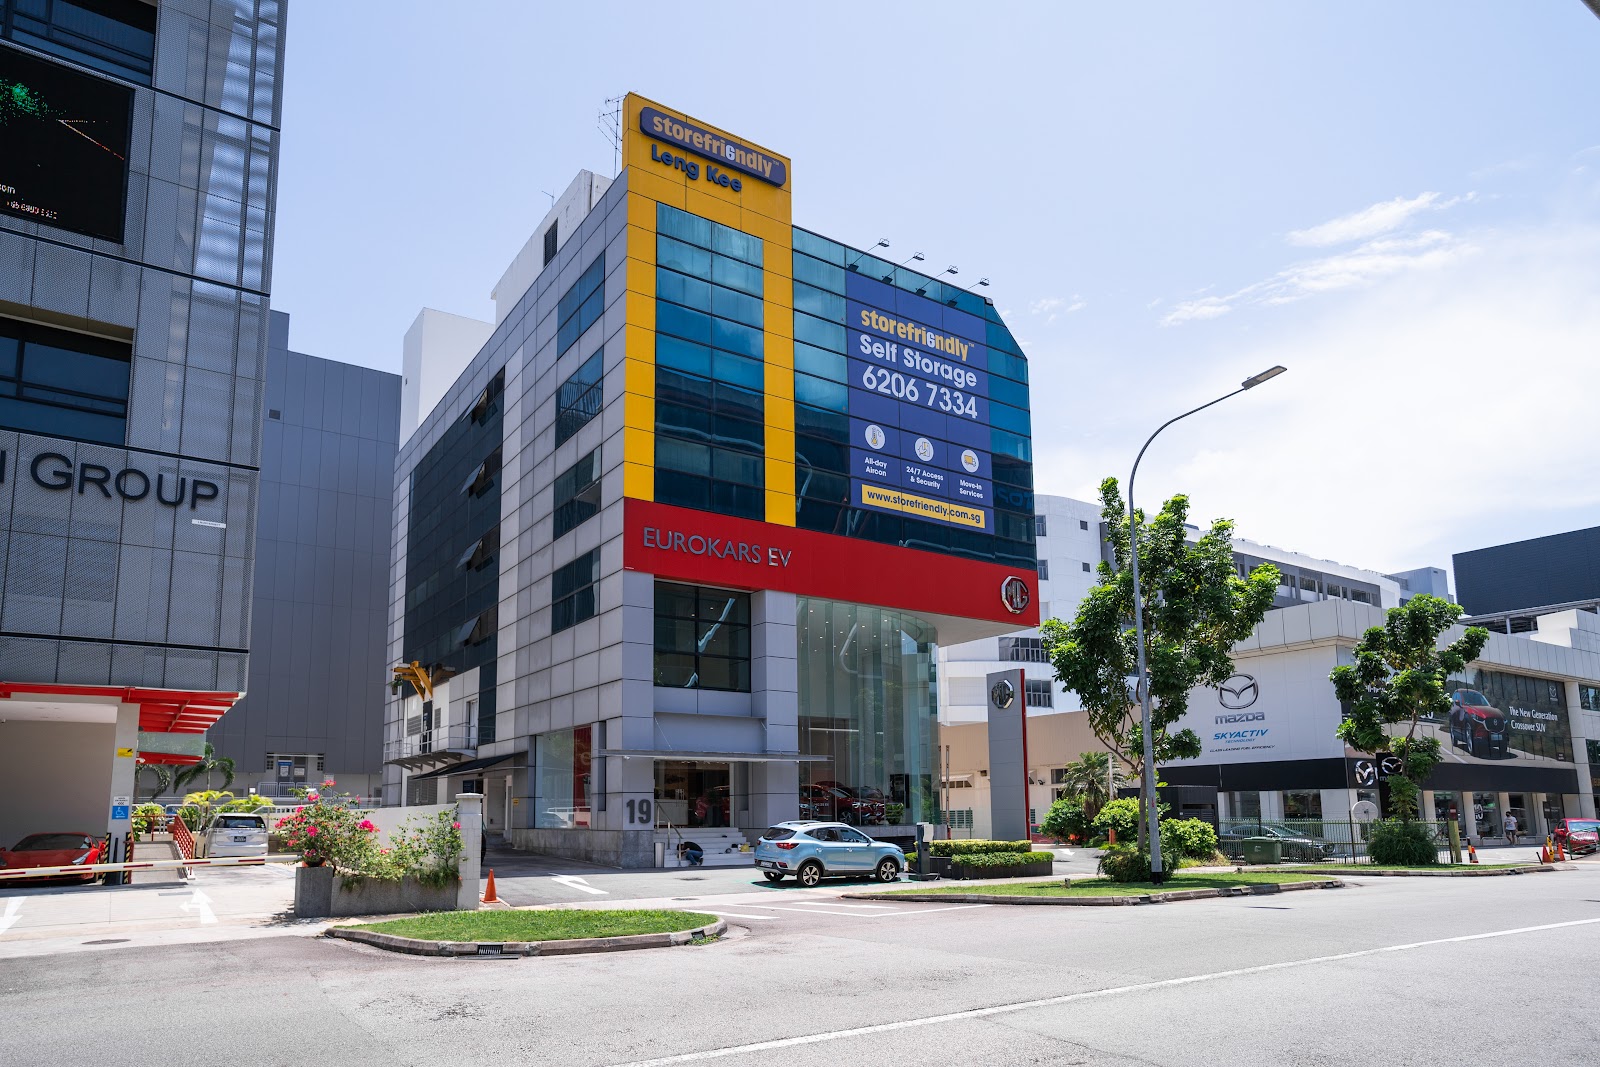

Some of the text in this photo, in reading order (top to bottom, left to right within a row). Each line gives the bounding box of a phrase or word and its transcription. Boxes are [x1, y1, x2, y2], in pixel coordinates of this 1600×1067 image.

[652, 143, 743, 192] Leng Kee
[860, 334, 977, 389] Self Storage
[862, 365, 978, 419] 6206 7334
[864, 456, 888, 470] All-day
[865, 465, 887, 477] Aircon
[30, 452, 219, 510] GROUP
[906, 465, 944, 481] 24/7 Access
[910, 475, 941, 489] & Security
[959, 487, 984, 499] Services
[867, 490, 981, 524] www.storefriendly.com.sg
[643, 526, 792, 568] EUROKARS EV
[1215, 711, 1265, 725] mazda
[1508, 705, 1559, 722] The New Generation
[1213, 728, 1269, 740] SKYACTIV
[1510, 719, 1546, 733] Crossover SUV
[626, 798, 652, 824] 19
